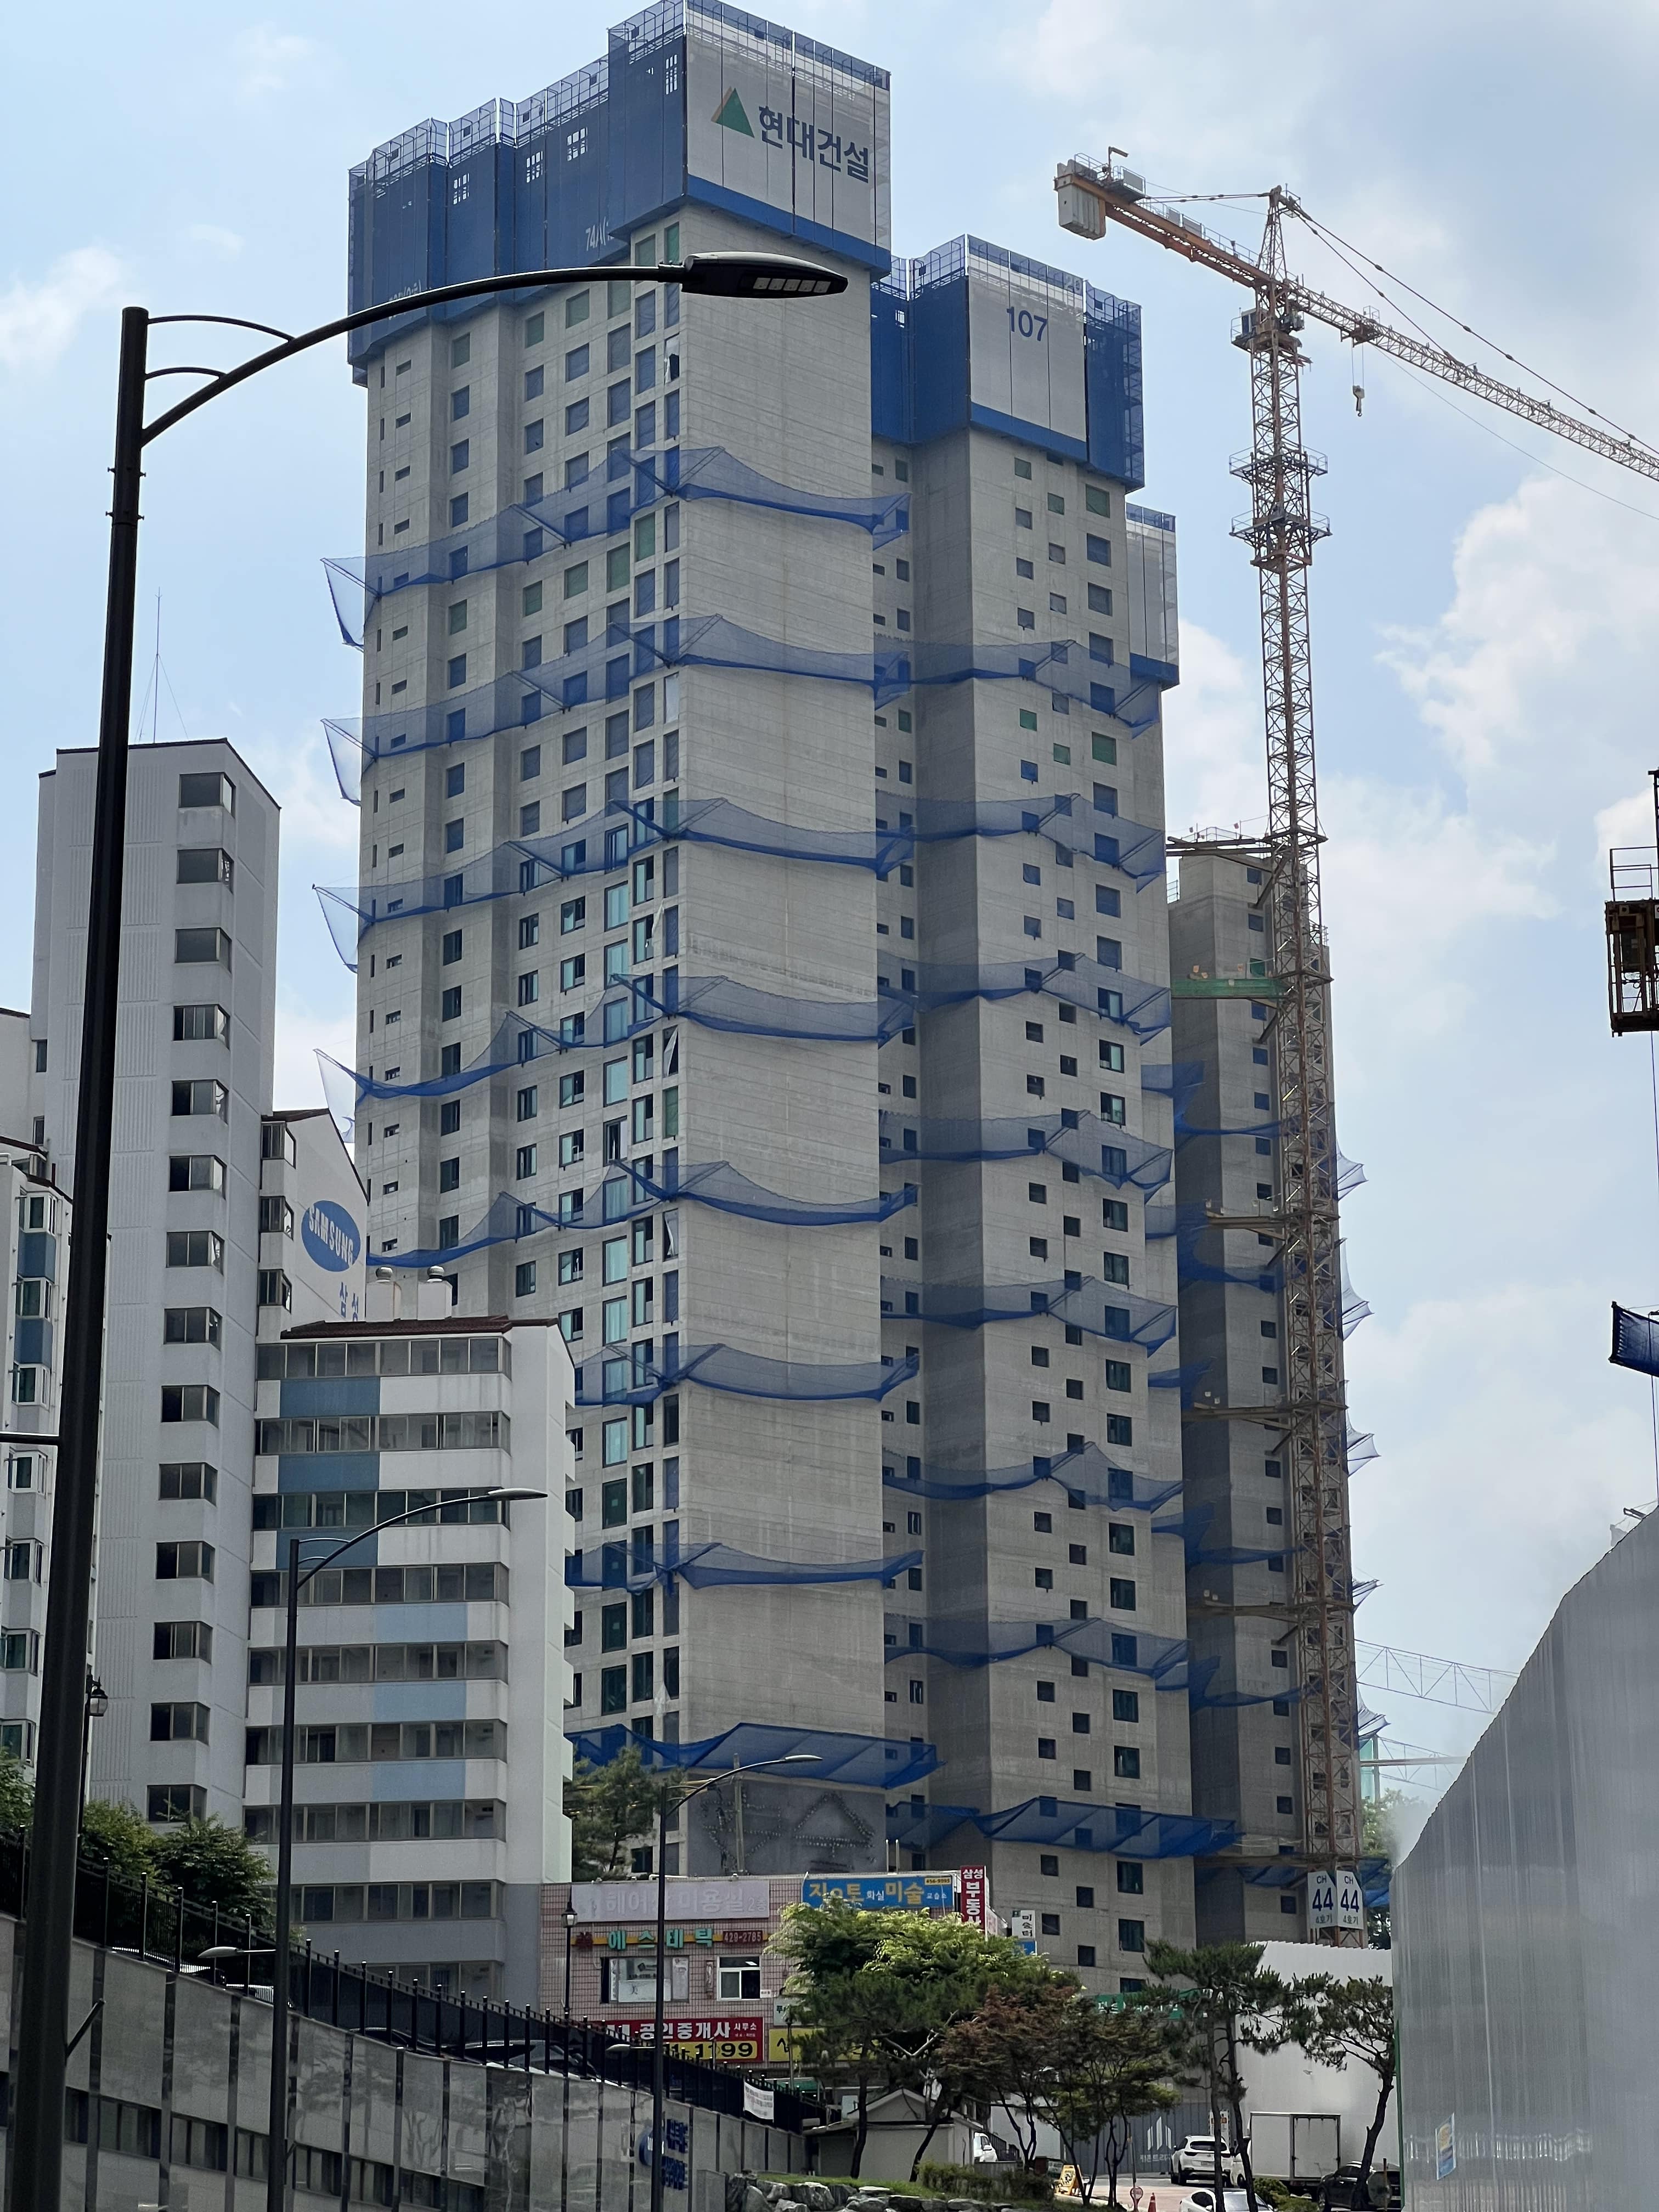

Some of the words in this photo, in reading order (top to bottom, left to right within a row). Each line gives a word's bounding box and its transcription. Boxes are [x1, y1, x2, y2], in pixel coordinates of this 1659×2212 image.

[758, 105, 869, 184] 현대건설
[1006, 306, 1048, 342] 107
[308, 1205, 354, 1266] SAMSUNG
[962, 1869, 984, 1880] 삼성
[1316, 1875, 1327, 1884] CH
[1344, 1875, 1354, 1885] CH
[678, 1887, 744, 1914] 미용실
[866, 1890, 885, 1901] 화실
[885, 1881, 925, 1905] 미술
[926, 1892, 948, 1900] 교습소
[1312, 1887, 1334, 1911] 44
[1340, 1888, 1359, 1913] 44
[1316, 1914, 1333, 1923] 4호기
[1343, 1915, 1359, 1925] 4호기
[607, 1927, 714, 1951] 에스테틱
[724, 1932, 762, 1943] 429-2785
[639, 2021, 731, 2040] 공인중개사
